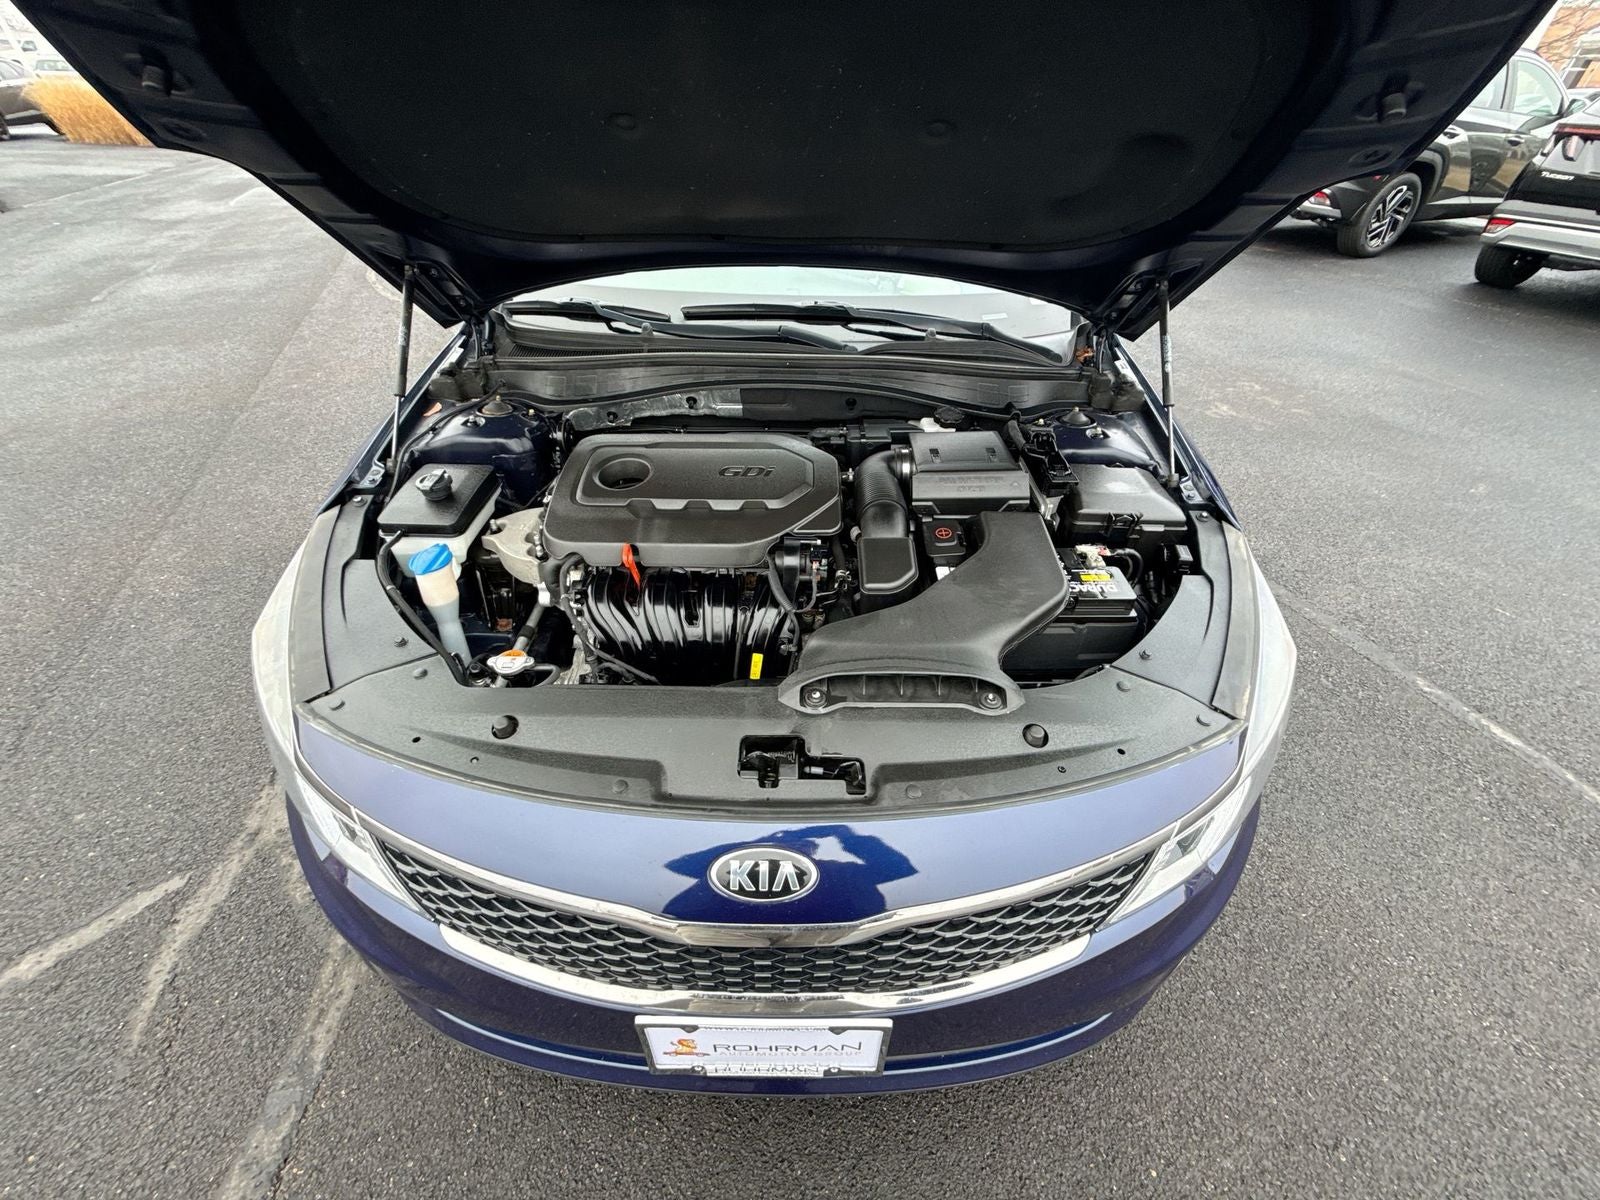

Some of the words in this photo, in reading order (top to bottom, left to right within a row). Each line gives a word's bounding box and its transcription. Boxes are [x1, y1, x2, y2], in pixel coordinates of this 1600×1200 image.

[1069, 584, 1118, 592] DURAC
[729, 860, 800, 891] KIA
[713, 1042, 862, 1052] ROHRMAN
